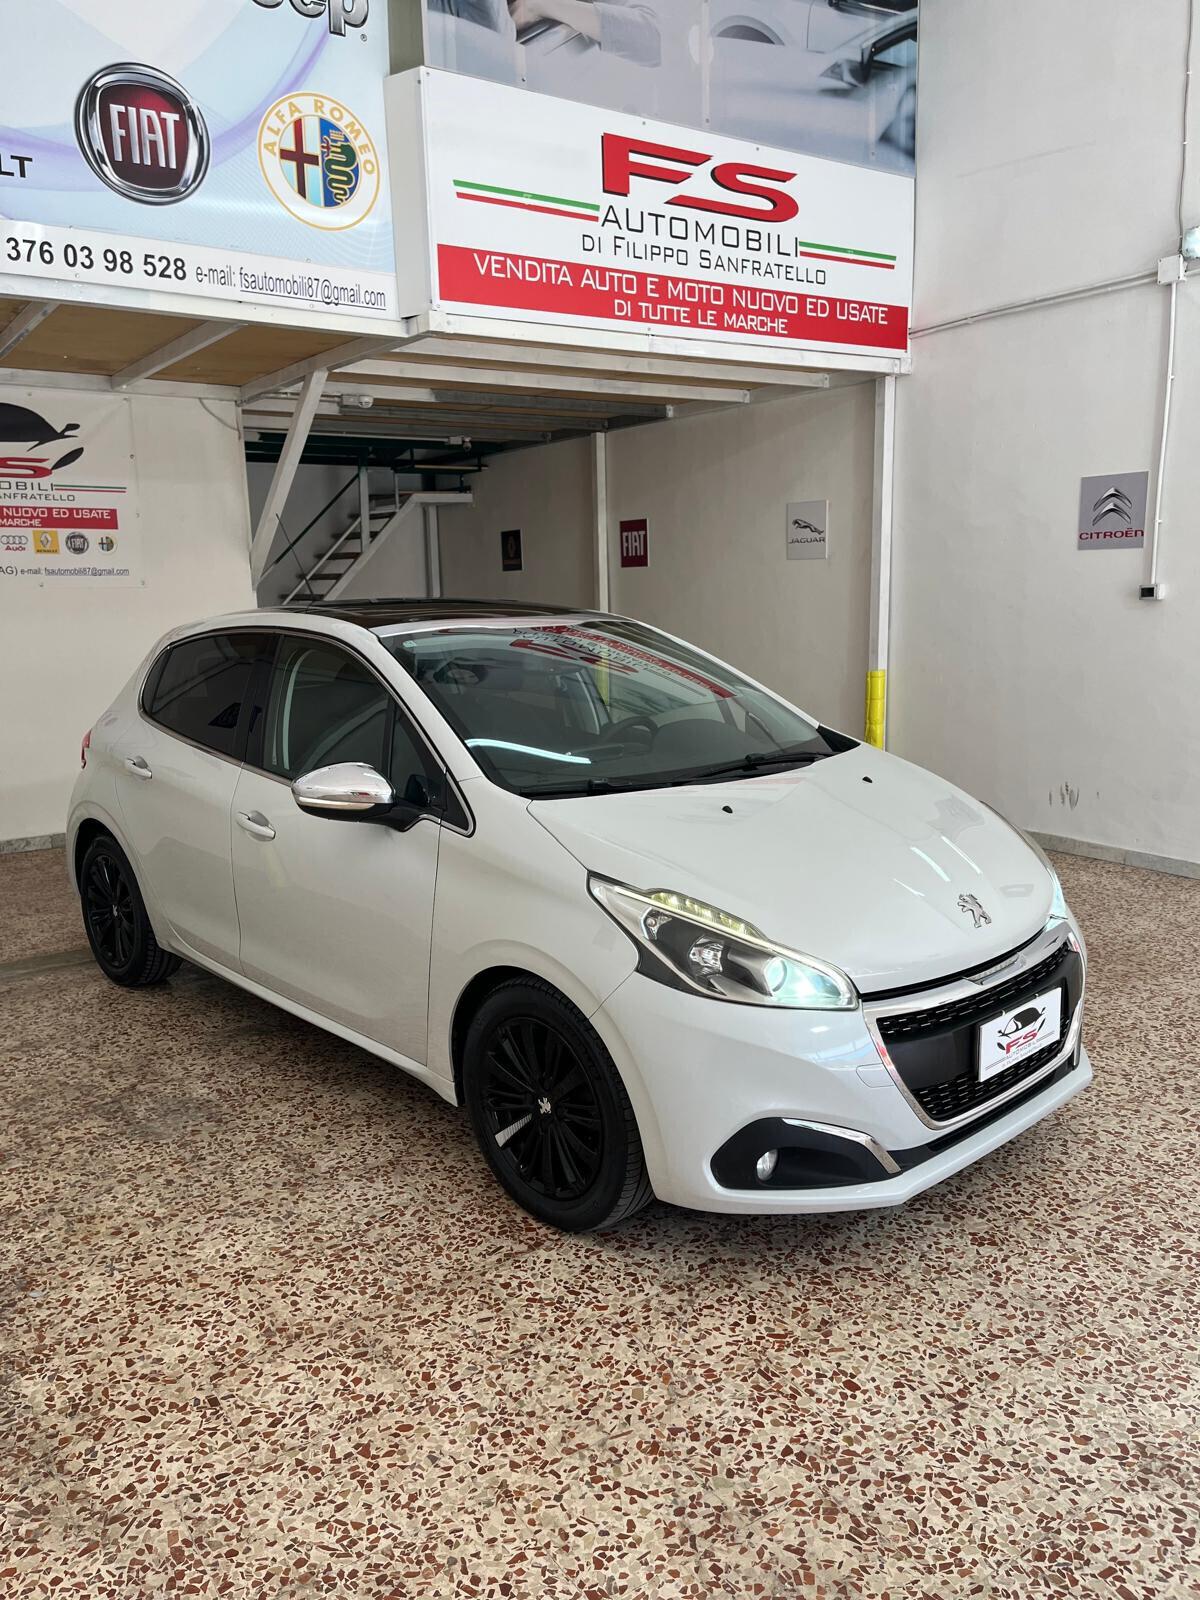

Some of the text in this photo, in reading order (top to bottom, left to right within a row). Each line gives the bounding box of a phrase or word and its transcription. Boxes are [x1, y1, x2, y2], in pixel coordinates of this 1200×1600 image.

[109, 103, 181, 170] FIAT
[263, 98, 376, 175] ALFA ROMEO
[601, 132, 799, 223] FS
[601, 204, 799, 258] AUTOMOBILI
[6, 236, 387, 310] 376 03 98 528 e-mail: fsautomobili87@gmail.com
[581, 234, 827, 285] DI FILIPPO SANFRATELLO
[473, 253, 889, 325] VENDITA AUTO E MOTO NUOVO ED USATE
[613, 299, 788, 334] DI TUTTE LE MARCHE
[3, 507, 111, 519] NUOVO ED USATE
[622, 530, 646, 557] FIAT
[787, 536, 826, 545] JAGUAR
[1005, 1028, 1039, 1055] FS
